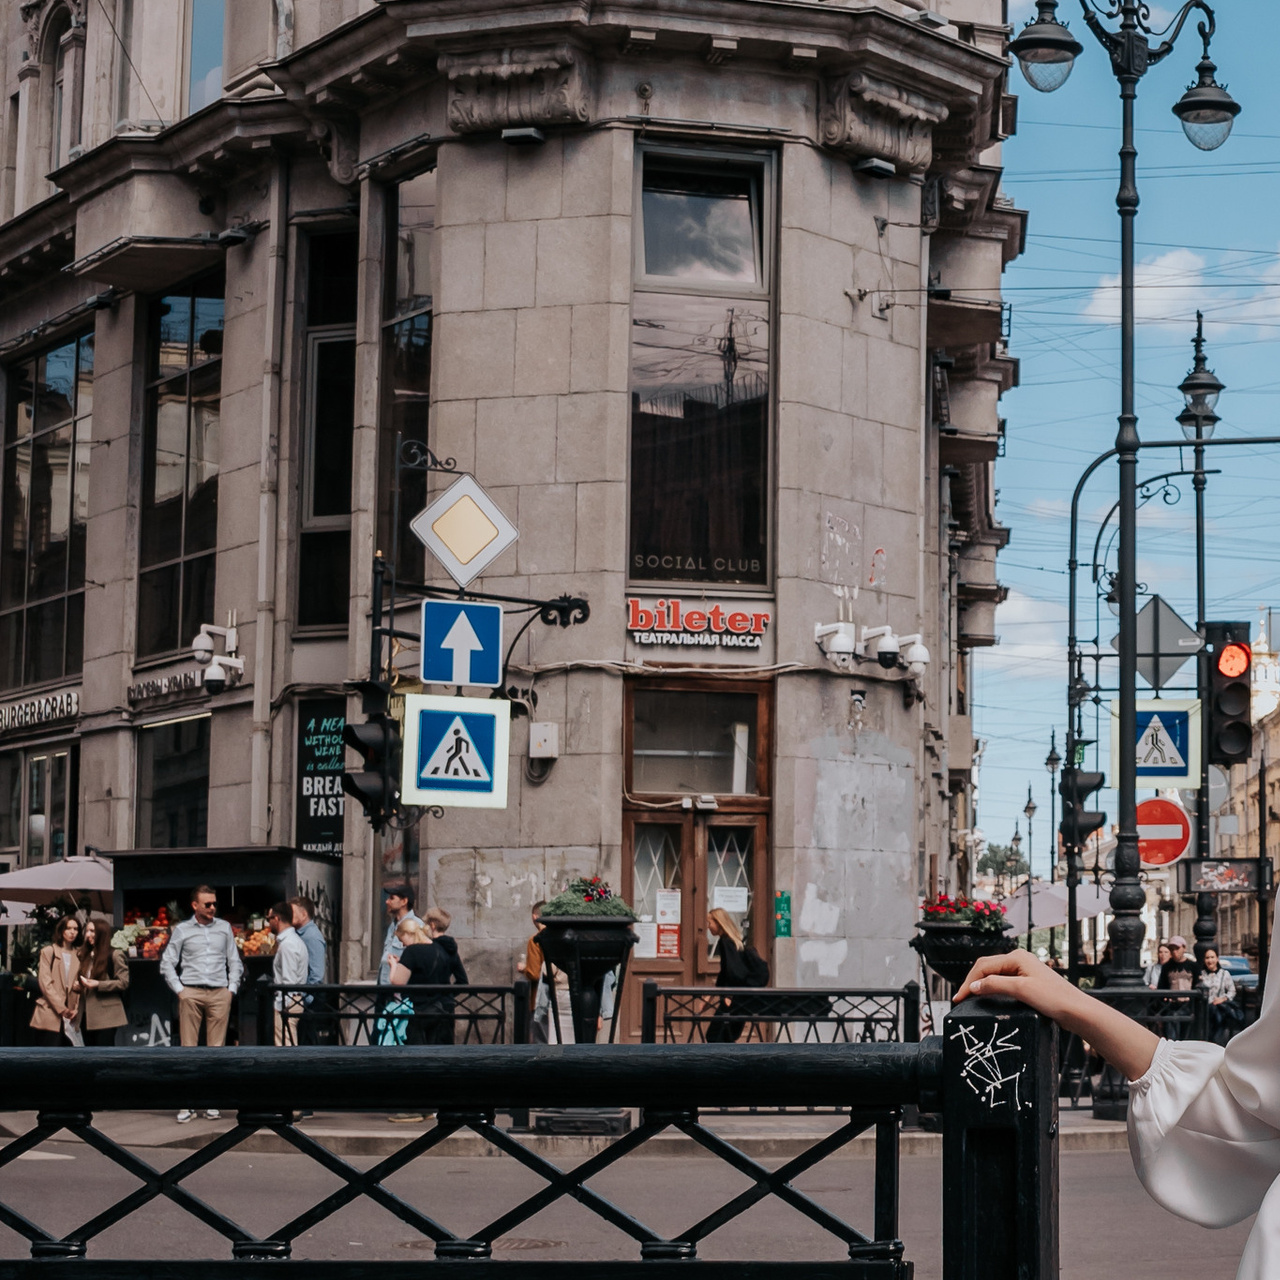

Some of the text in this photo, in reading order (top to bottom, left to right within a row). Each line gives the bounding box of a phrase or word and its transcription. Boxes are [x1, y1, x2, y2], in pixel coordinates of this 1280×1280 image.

[634, 554, 760, 572] SOCIAL CLUB
[627, 598, 771, 634] bileter
[633, 632, 762, 647] ТЕАТРАЛЬНАЯ КАССА
[306, 717, 345, 733] A MEA
[314, 745, 342, 757] WINE
[302, 776, 344, 796] BREA
[309, 797, 346, 817] FAST
